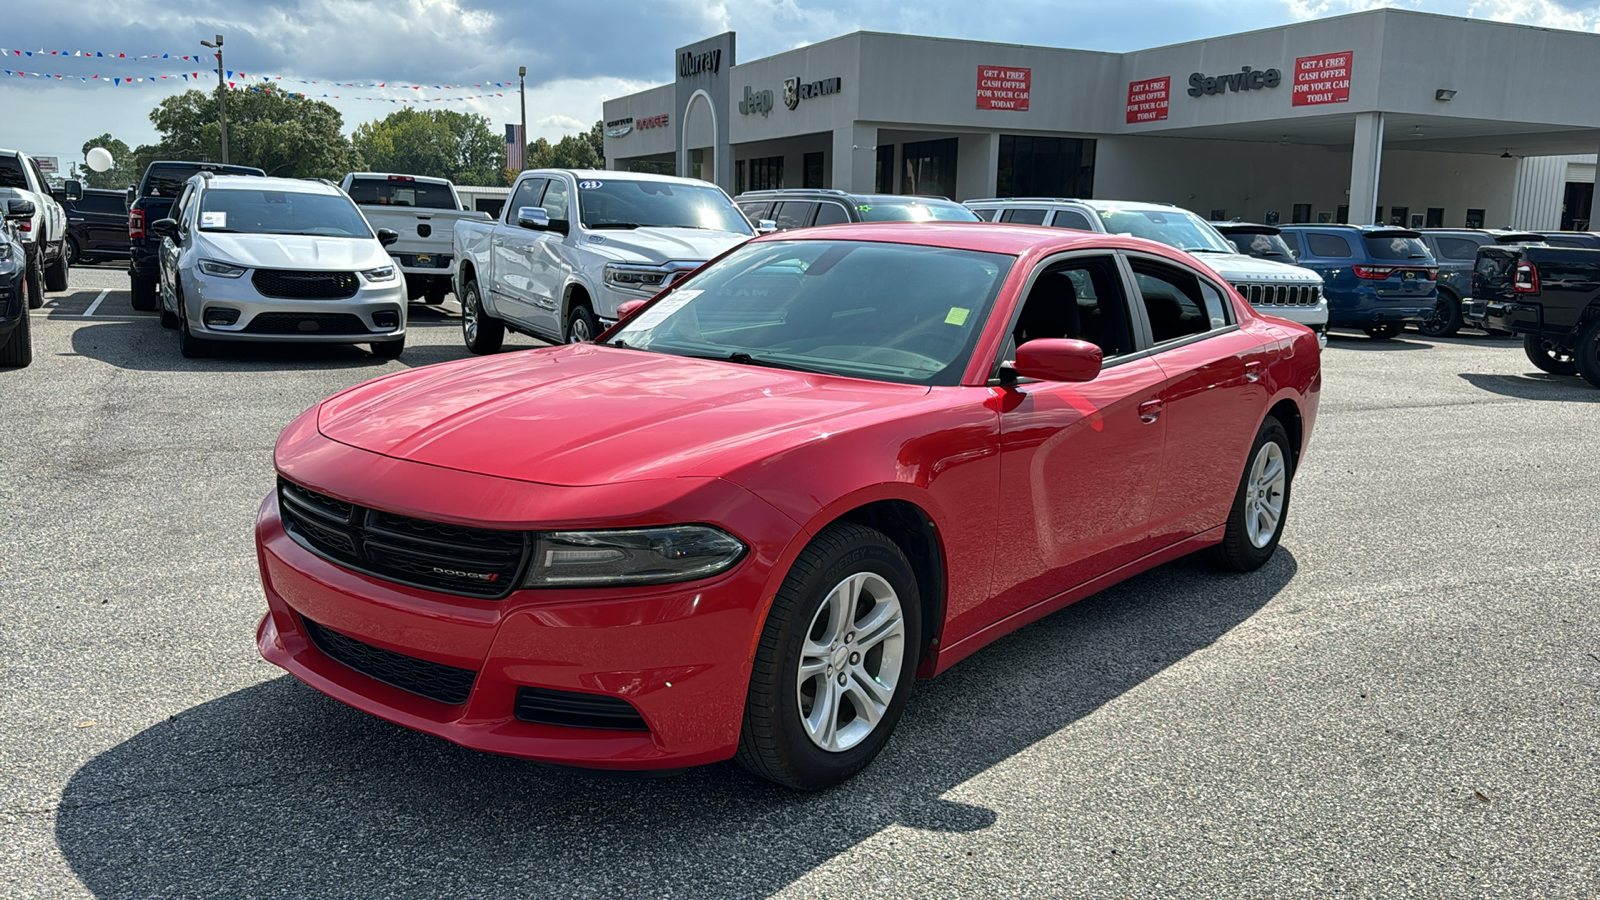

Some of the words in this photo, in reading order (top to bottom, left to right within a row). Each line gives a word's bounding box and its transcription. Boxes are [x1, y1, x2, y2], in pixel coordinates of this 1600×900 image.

[679, 50, 721, 77] Murray
[1301, 61, 1317, 70] GET
[1325, 57, 1346, 68] FREE
[983, 69, 999, 78] GET
[1006, 71, 1025, 80] FREE
[1299, 72, 1319, 81] CASH
[1320, 69, 1346, 79] OFFER
[981, 80, 1001, 88] CASH
[1002, 81, 1026, 90] OFFER
[1150, 81, 1166, 91] FREE
[1187, 66, 1282, 98] Service
[1294, 84, 1309, 93] FOR
[1310, 82, 1332, 91] YOUR
[1332, 80, 1350, 89] CAR
[800, 77, 841, 100] RAM
[977, 90, 992, 98] FOR
[993, 90, 1013, 99] YOUR
[1014, 91, 1029, 99] CAR
[739, 86, 773, 118] Jeep
[1131, 94, 1146, 103] CASH
[1146, 91, 1166, 100] OFFER
[1306, 92, 1333, 103] TODAY
[990, 100, 1015, 108] TODAY
[1127, 104, 1139, 112] FOR
[1139, 102, 1155, 111] YOUR
[1156, 100, 1168, 109] CAR
[1137, 111, 1157, 120] TODAY
[636, 114, 669, 131] DODGE
[433, 567, 490, 580] DODGE
